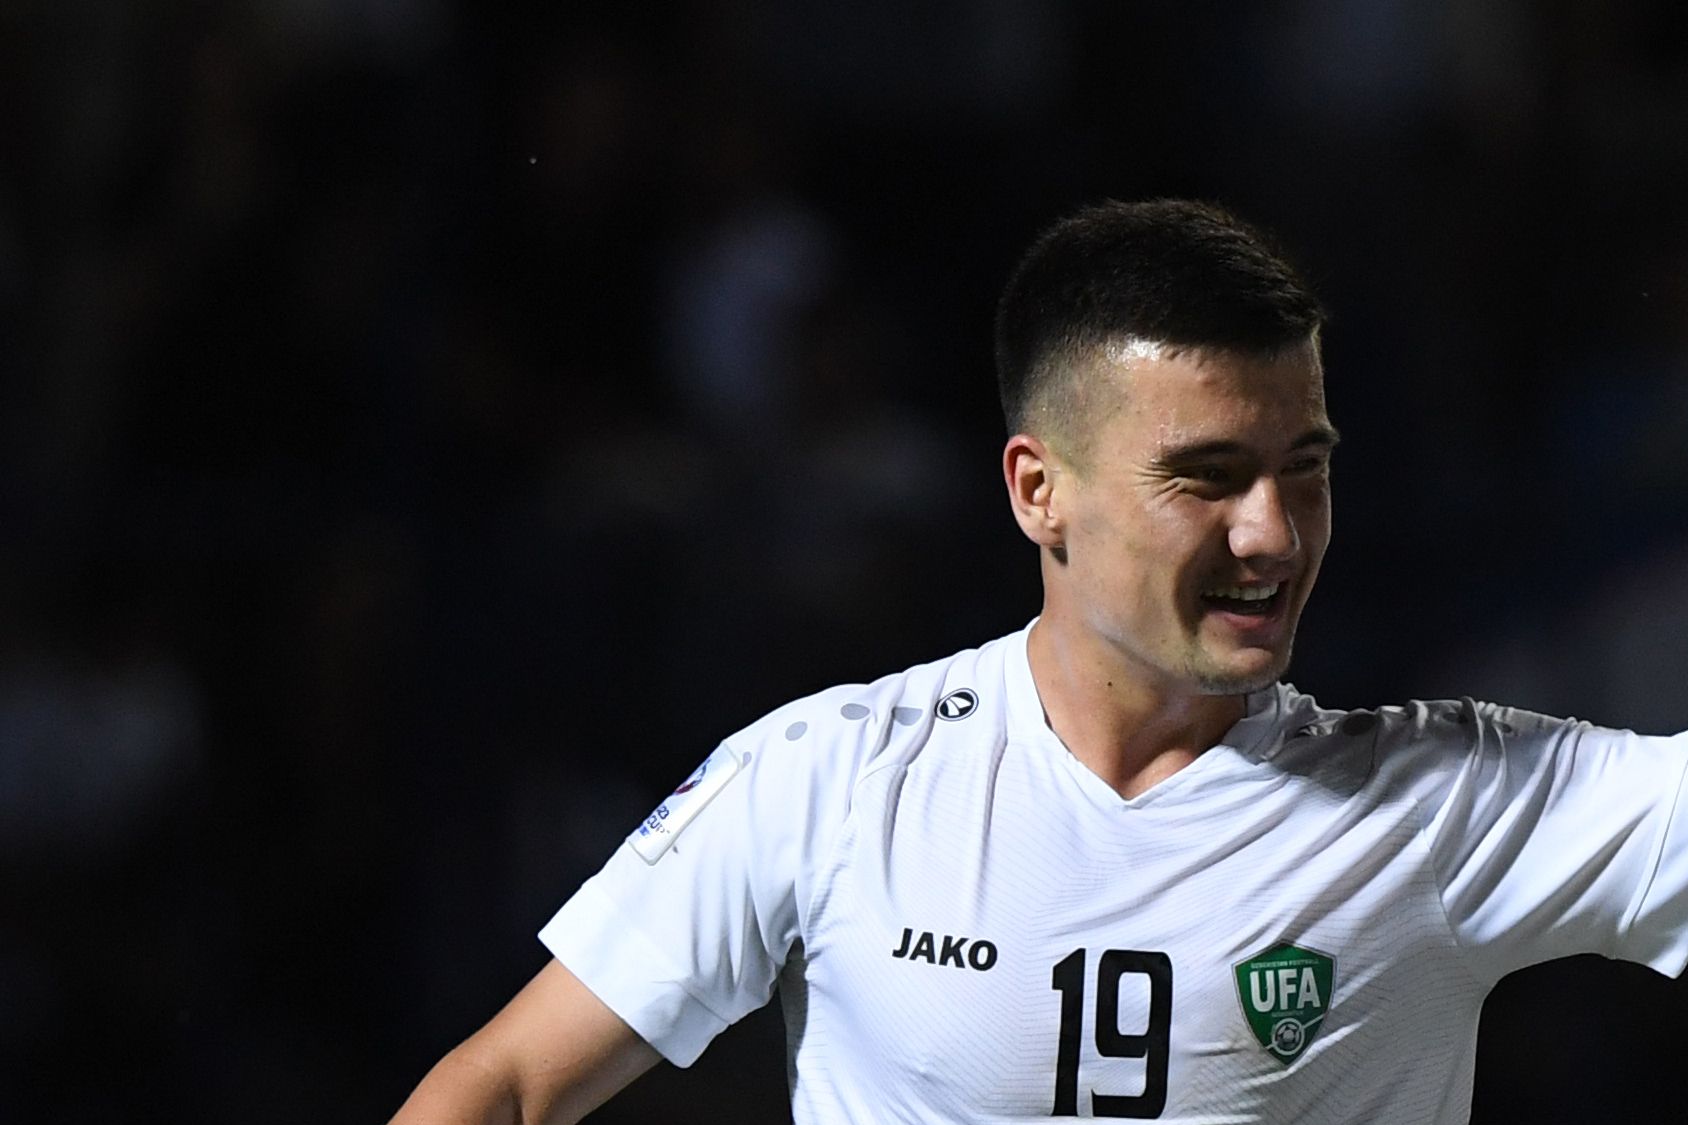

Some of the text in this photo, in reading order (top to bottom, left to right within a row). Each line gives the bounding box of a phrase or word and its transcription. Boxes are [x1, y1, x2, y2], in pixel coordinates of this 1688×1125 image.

[892, 927, 998, 972] JAKO
[1249, 966, 1322, 1013] UFA
[1051, 948, 1174, 1120] 19
